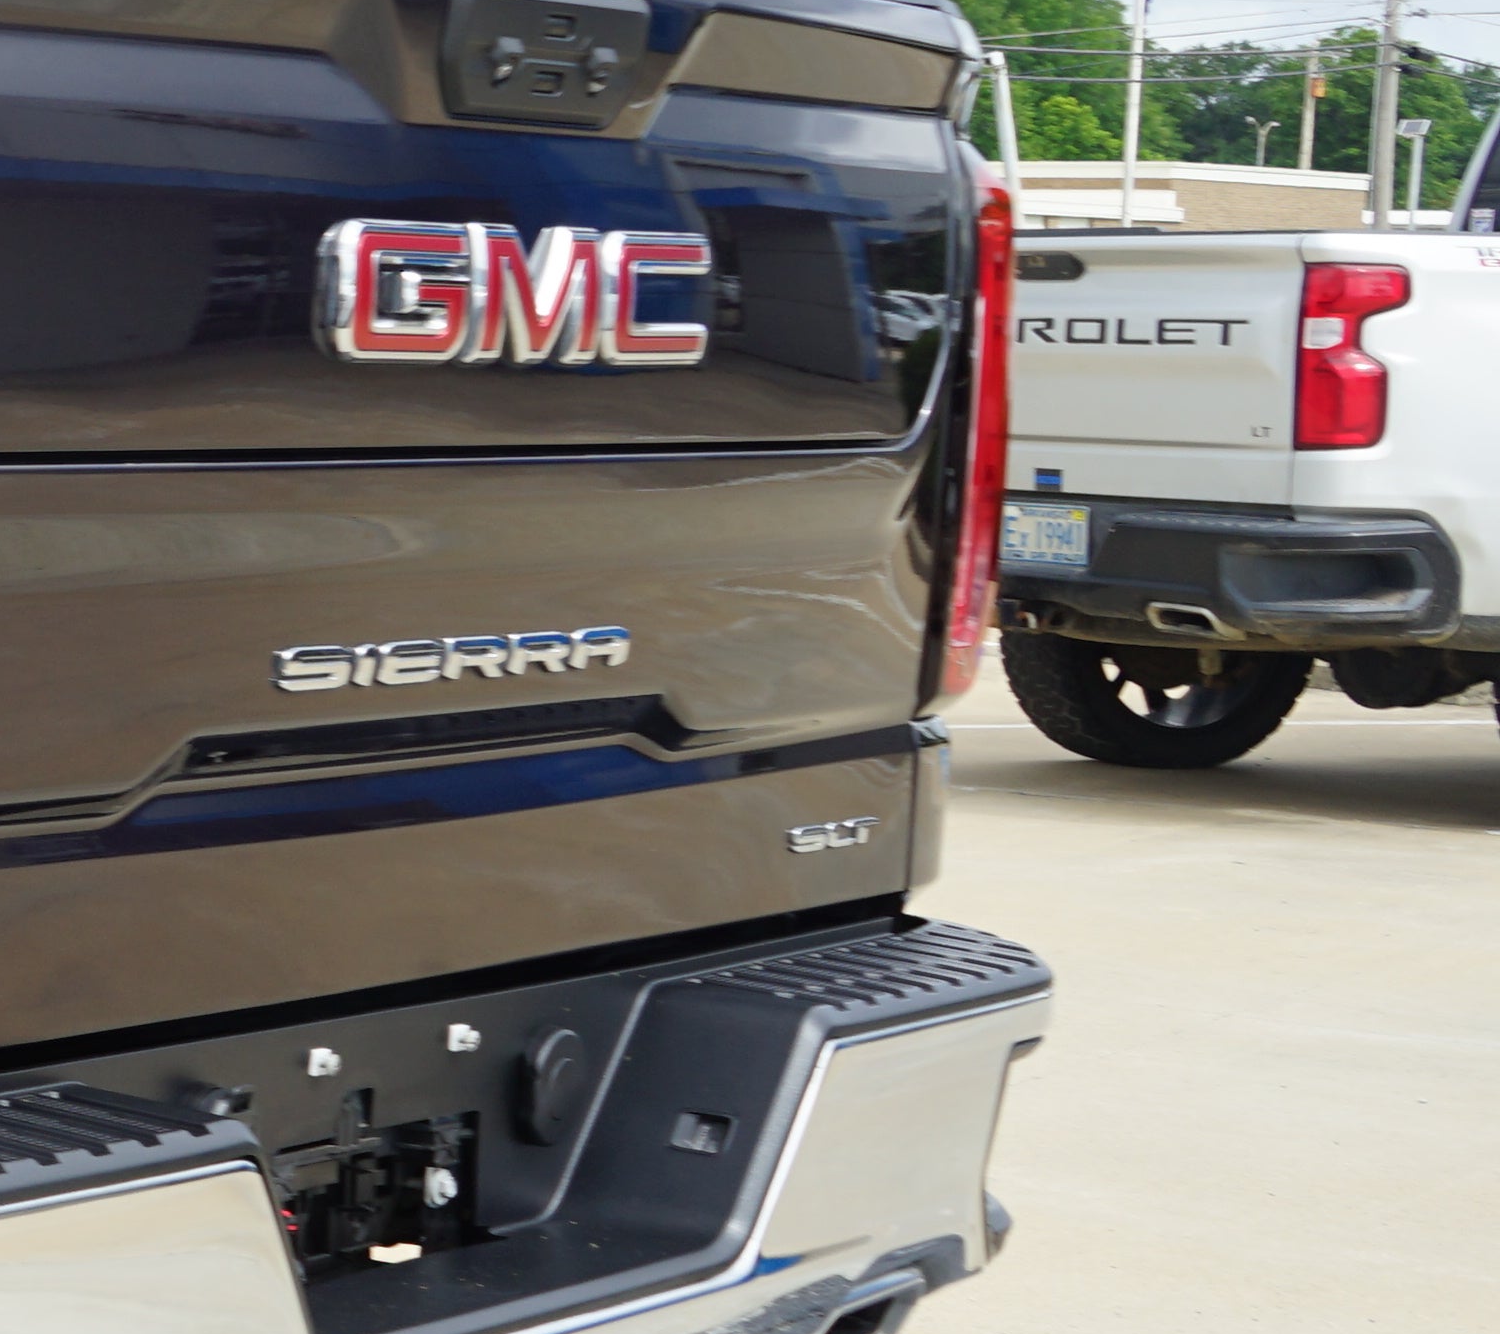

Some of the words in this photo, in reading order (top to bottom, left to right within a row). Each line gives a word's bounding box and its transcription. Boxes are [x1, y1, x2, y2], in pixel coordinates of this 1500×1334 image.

[316, 218, 712, 366] GMC
[1014, 317, 1250, 347] ROLET
[270, 624, 631, 692] SIERRA
[785, 816, 881, 853] SLT
